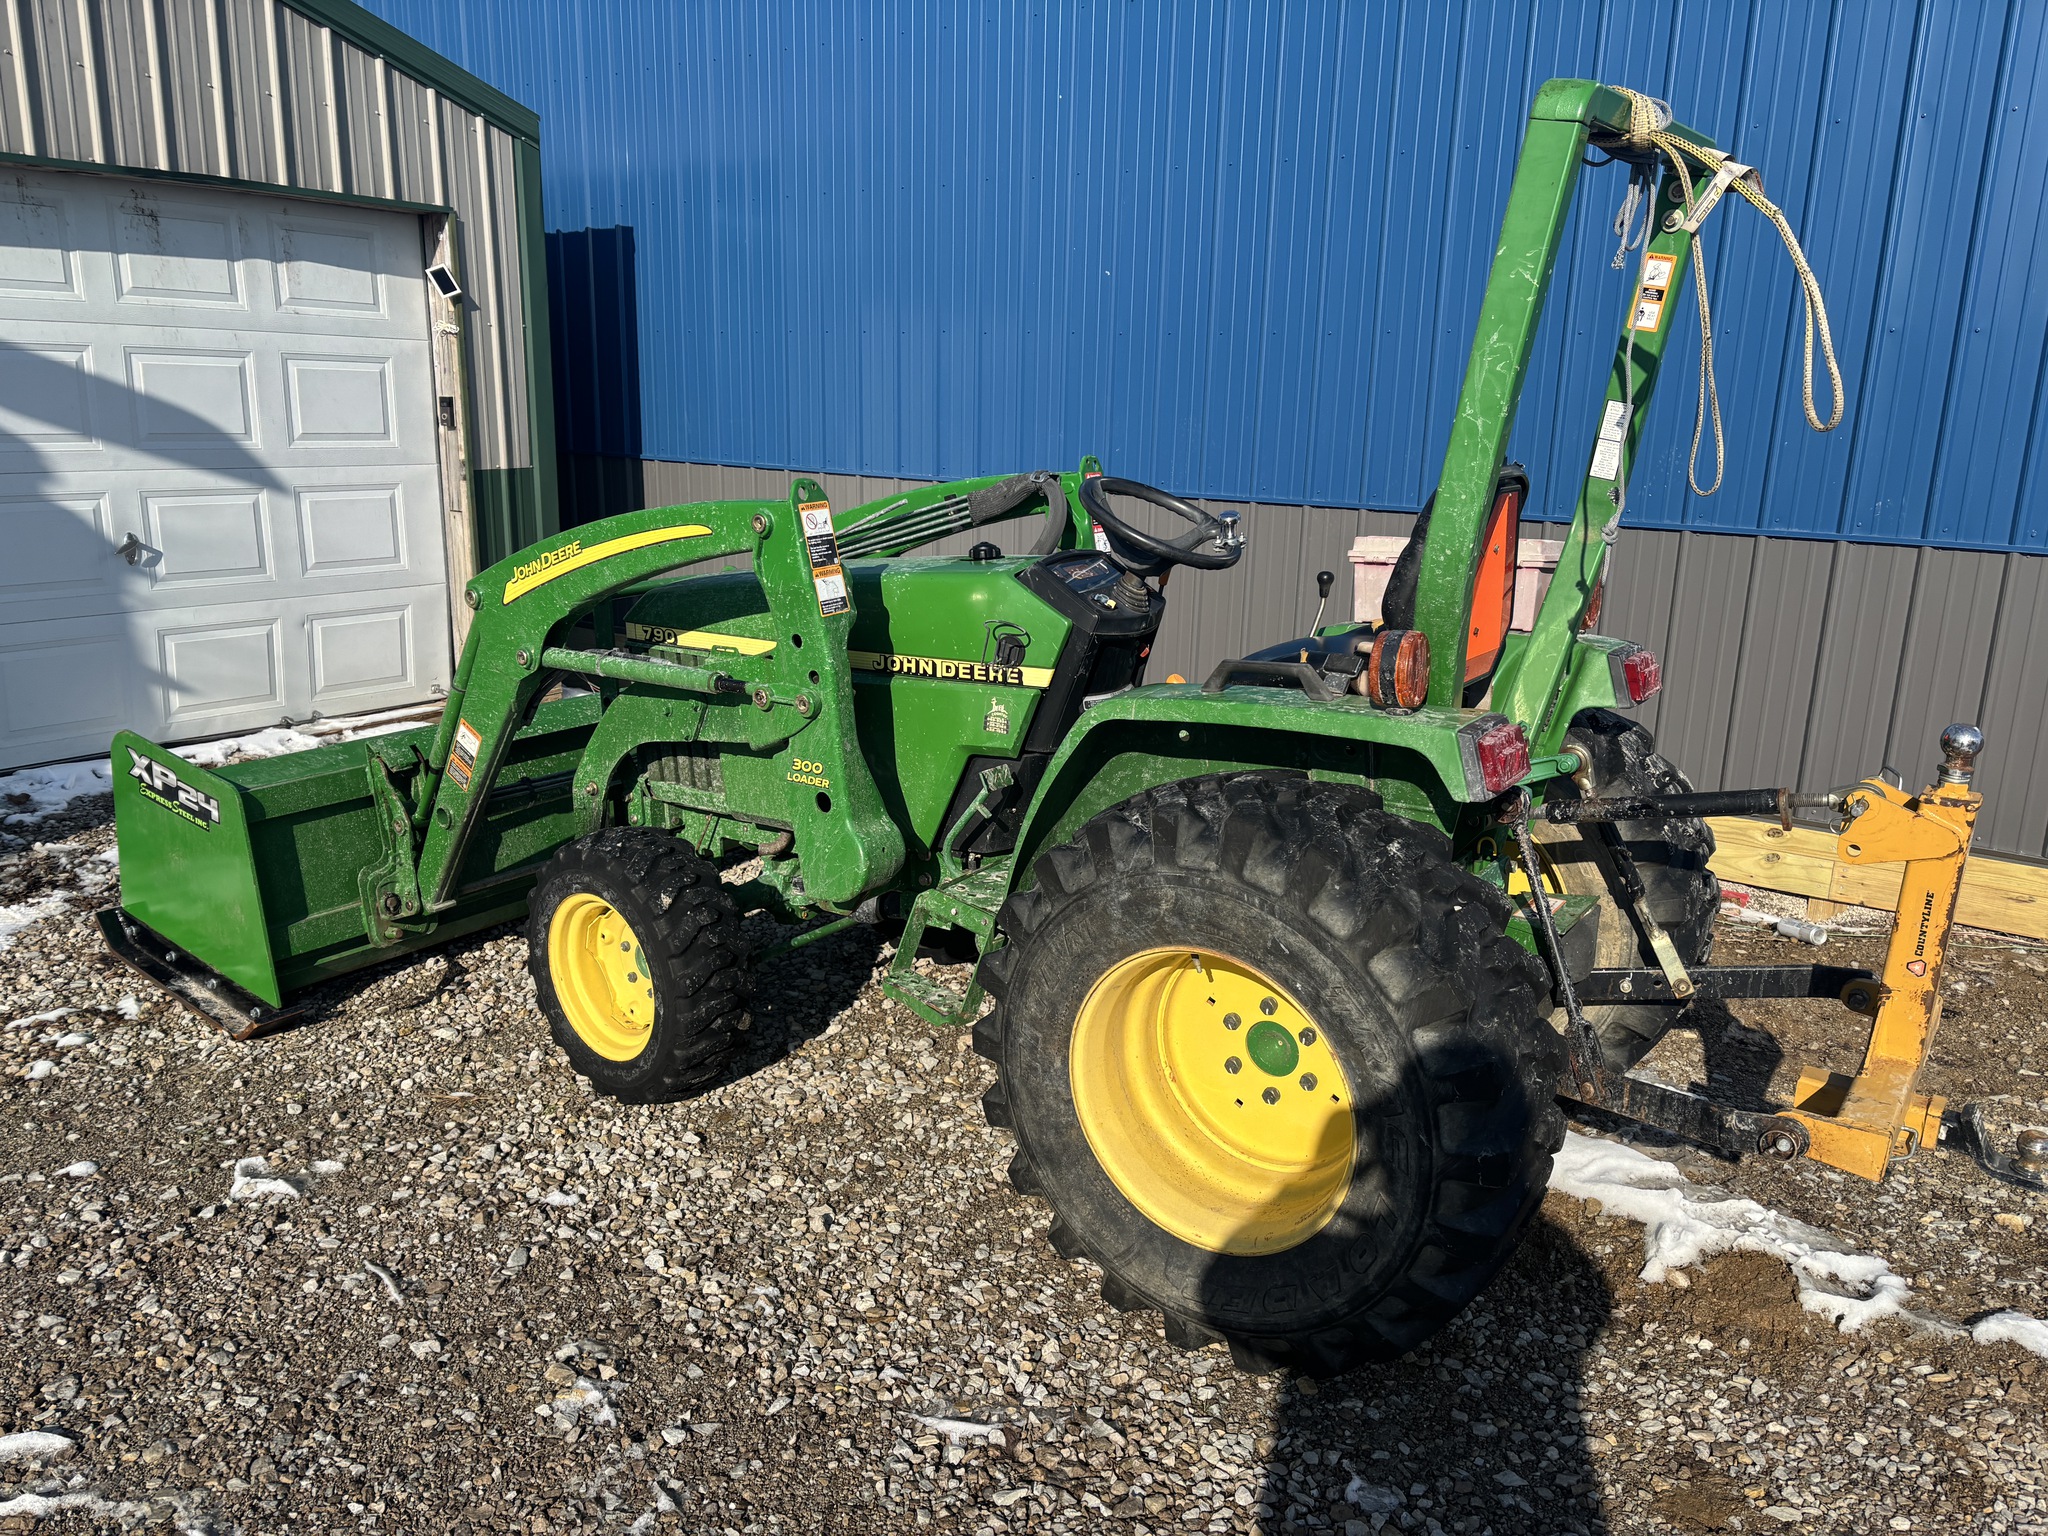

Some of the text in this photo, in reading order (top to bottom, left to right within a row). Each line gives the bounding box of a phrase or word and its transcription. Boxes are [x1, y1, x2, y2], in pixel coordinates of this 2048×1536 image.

[805, 502, 828, 510] WARNING
[511, 540, 582, 583] JOHN DEERE
[818, 567, 841, 577] WARNING
[642, 626, 677, 645] 790
[873, 655, 1022, 685] JOHN DEERE
[792, 757, 823, 775] 300
[126, 747, 219, 823] XP24
[786, 771, 831, 789] LOADER
[140, 782, 173, 809] EXPRESS
[171, 800, 195, 822] STEEL
[1914, 891, 1935, 957] COUNTYLINE
